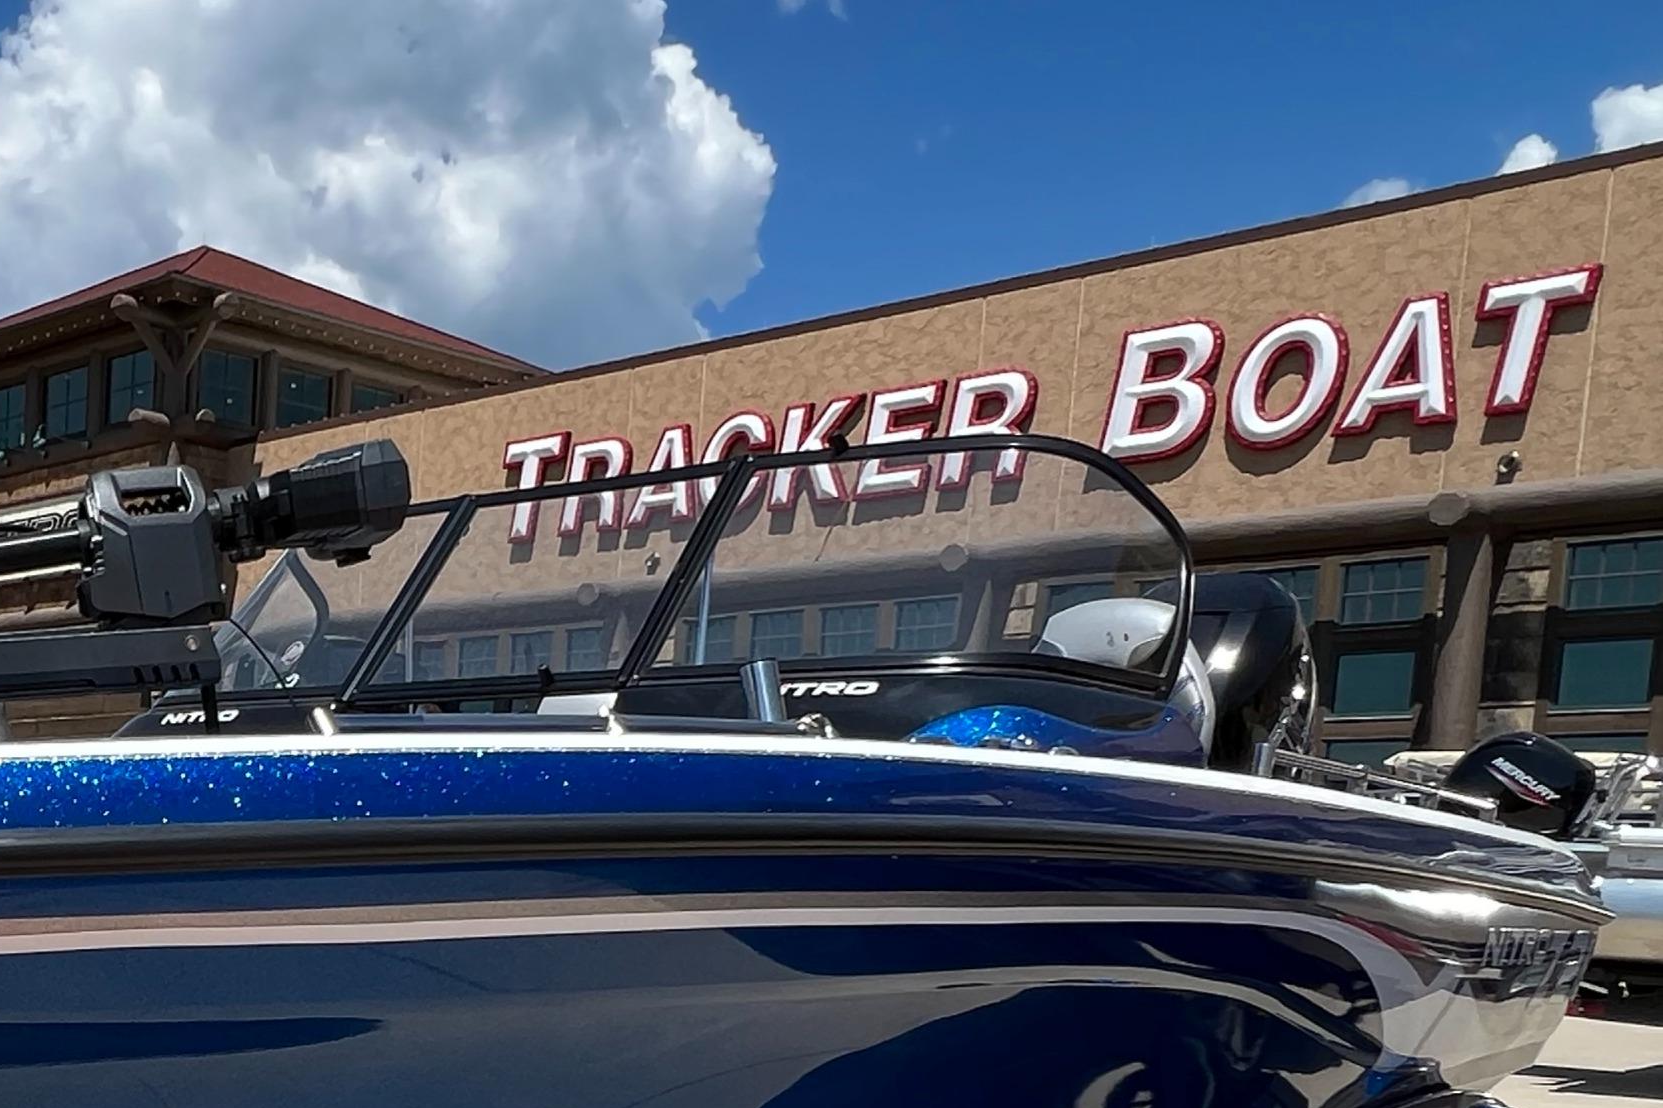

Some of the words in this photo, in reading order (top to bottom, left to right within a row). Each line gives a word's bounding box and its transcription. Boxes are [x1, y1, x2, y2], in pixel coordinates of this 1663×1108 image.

[504, 366, 1039, 544] TRACKER
[1098, 262, 1604, 465] BOAT
[780, 681, 880, 697] ITRO
[1491, 757, 1561, 800] MERCURY
